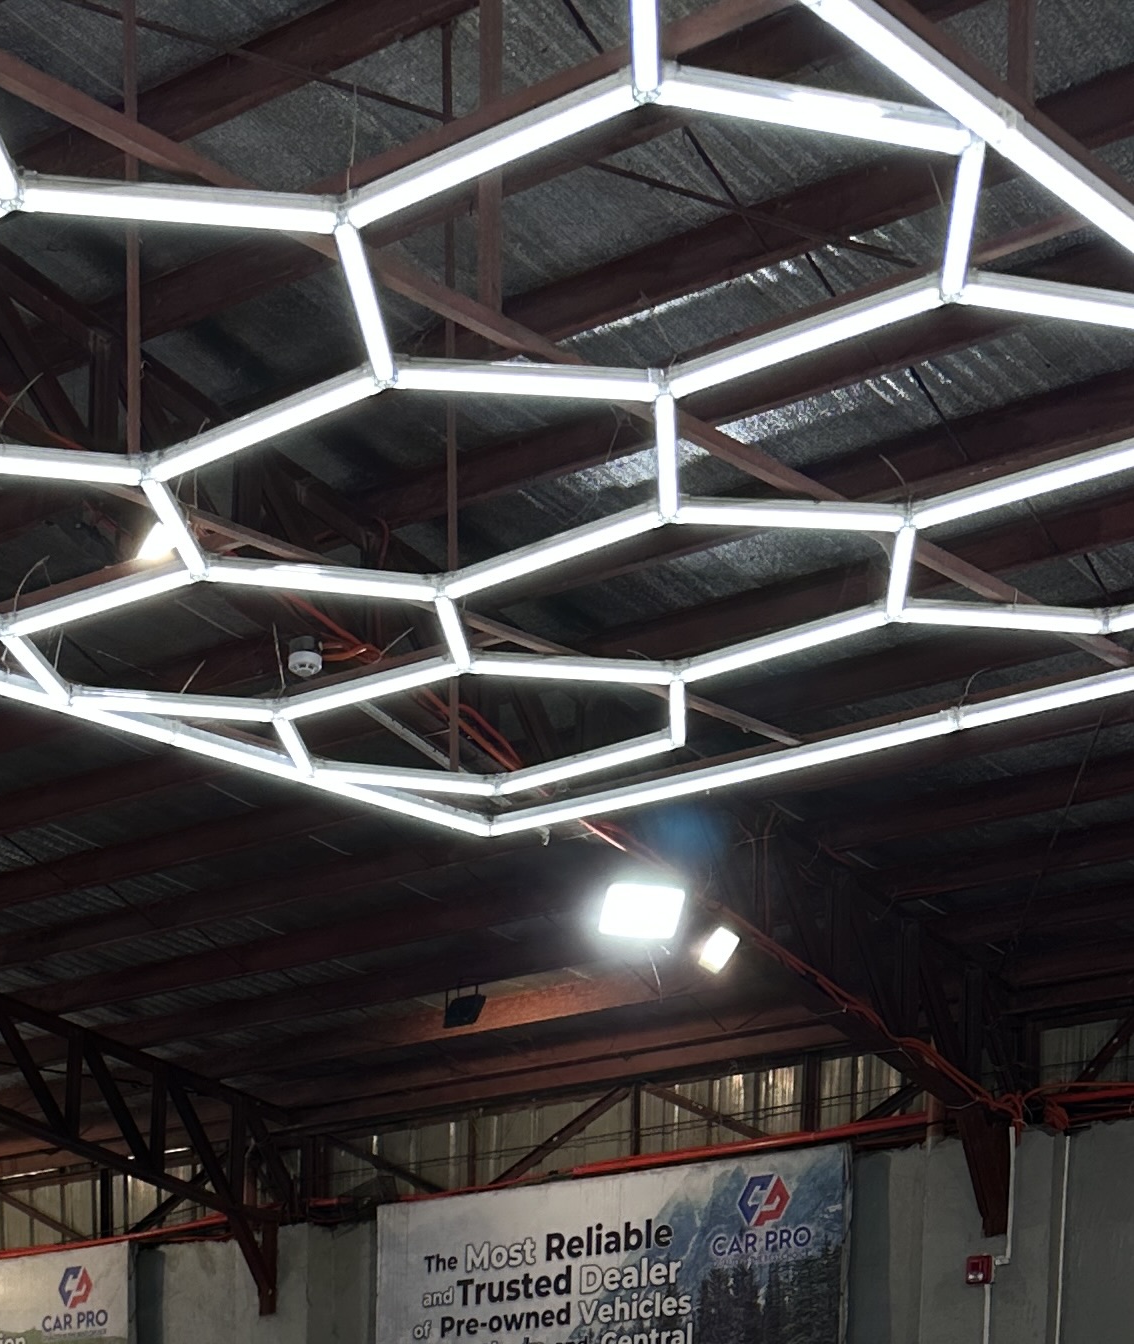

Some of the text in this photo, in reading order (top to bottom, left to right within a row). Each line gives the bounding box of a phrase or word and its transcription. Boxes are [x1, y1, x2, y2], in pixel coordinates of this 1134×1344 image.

[425, 1254, 458, 1273] The
[465, 1237, 536, 1272] Most
[545, 1218, 673, 1261] Reliable
[712, 1226, 811, 1256] CAR PRO
[422, 1286, 454, 1308] and
[457, 1265, 572, 1306] Trusted
[579, 1258, 681, 1296] Dealer
[42, 1309, 108, 1332] CAR PRO
[413, 1291, 692, 1340] of Pre-owned Vehicles
